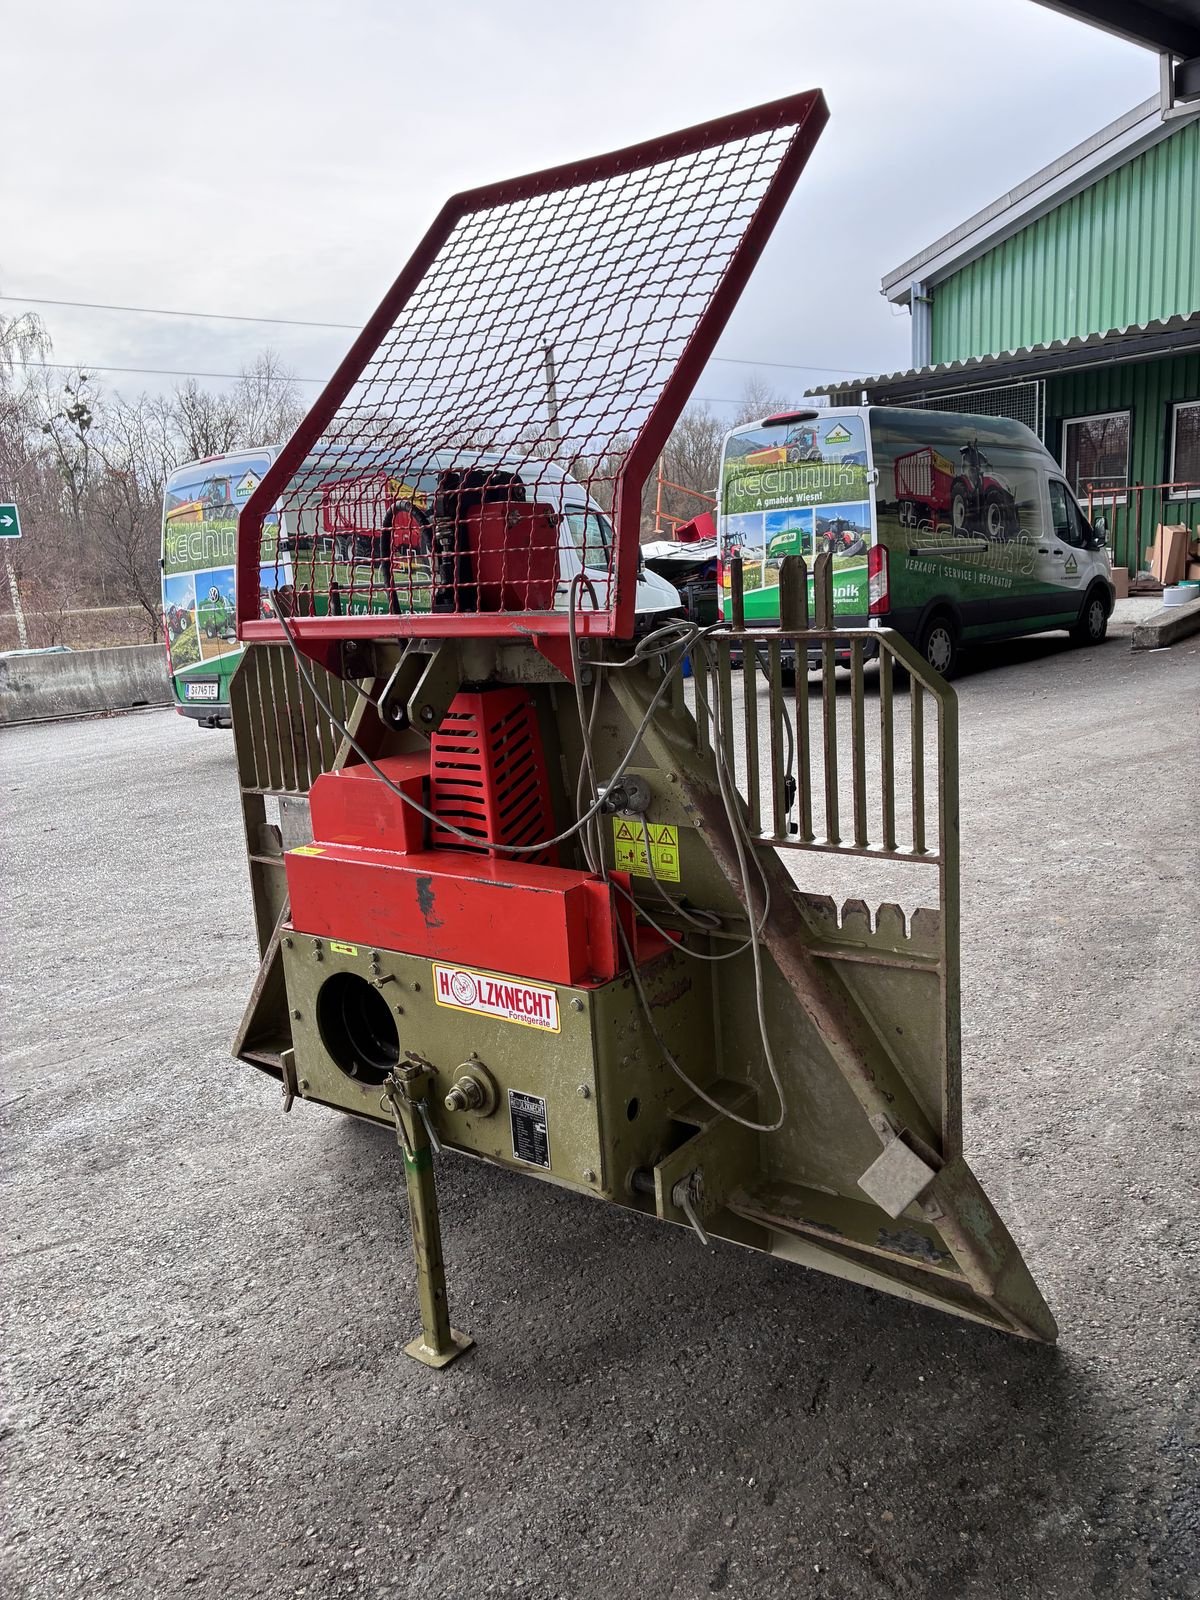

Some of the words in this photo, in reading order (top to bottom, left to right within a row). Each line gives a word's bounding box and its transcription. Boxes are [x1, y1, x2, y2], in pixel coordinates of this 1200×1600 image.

[731, 455, 855, 497] technik
[756, 498, 762, 506] A
[795, 491, 823, 502] Wiesn!
[166, 520, 273, 564] technk
[905, 559, 936, 574] VERKAUF
[944, 566, 972, 581] SERVICE
[979, 573, 1013, 589] REPARATUR
[440, 971, 552, 1019] HOLZKNECHT
[508, 1010, 551, 1028] Forstgeräte
